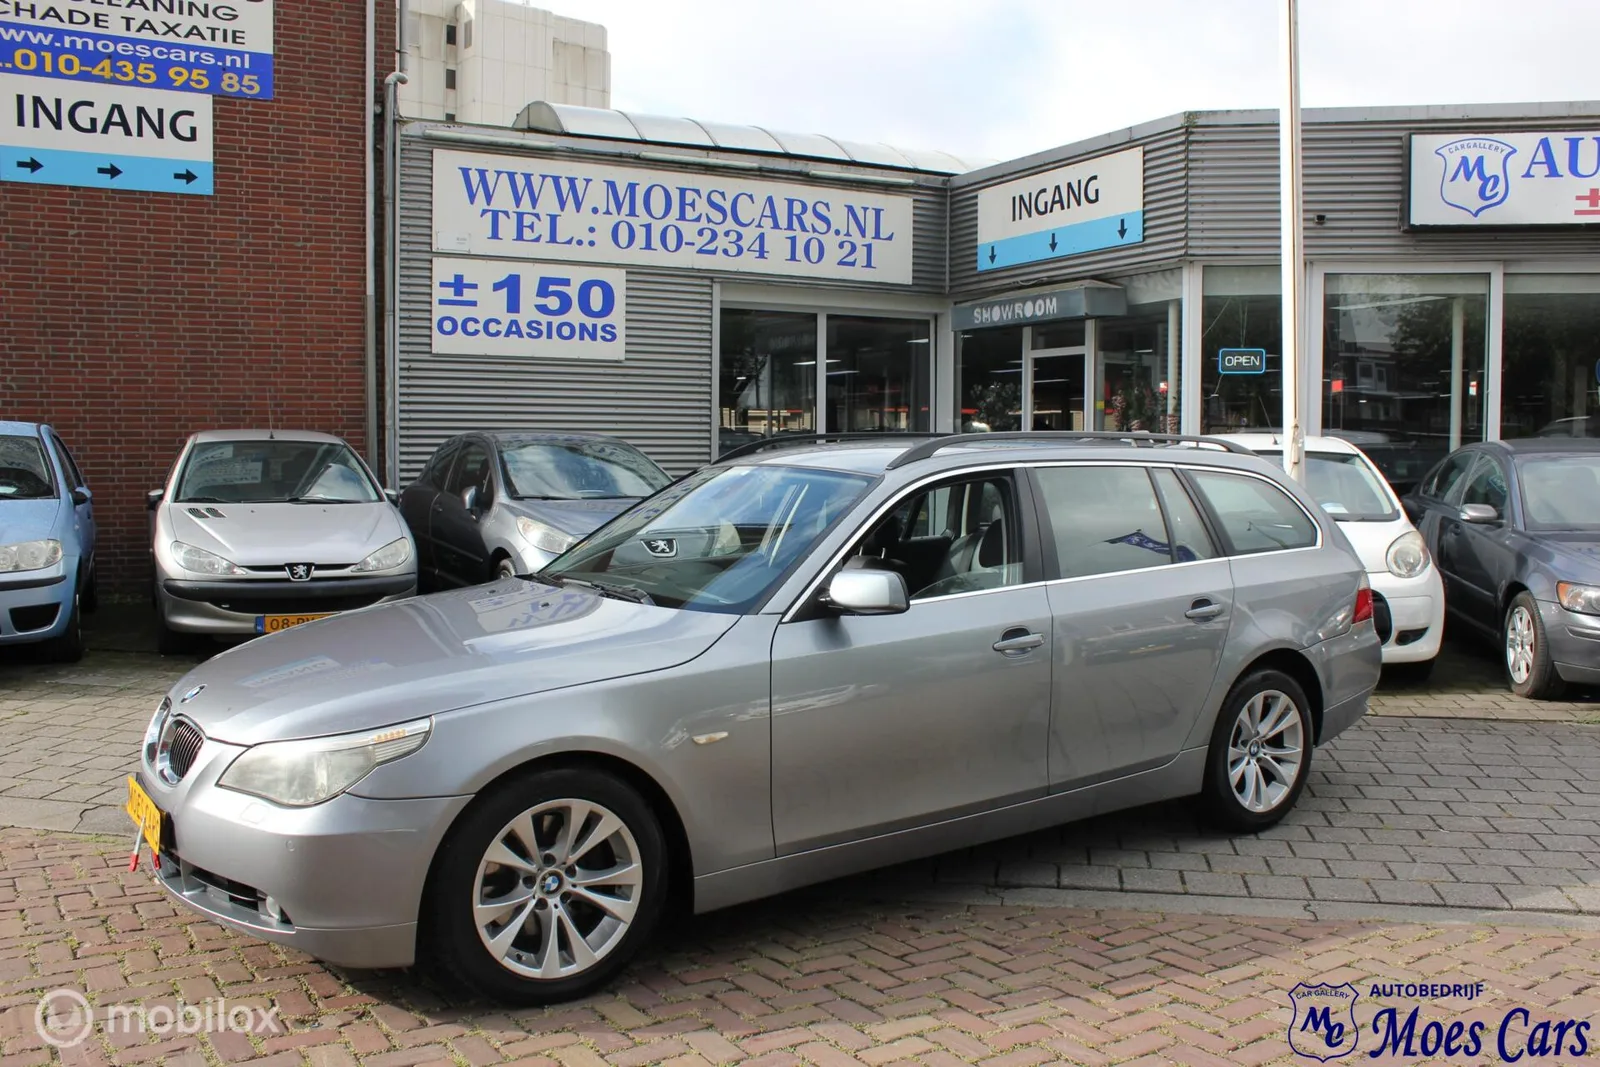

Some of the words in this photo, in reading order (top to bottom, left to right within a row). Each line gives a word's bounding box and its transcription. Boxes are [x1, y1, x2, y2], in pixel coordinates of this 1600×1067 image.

[69, 0, 239, 21] ANING
[121, 16, 246, 45] TAXATIE
[0, 48, 157, 84] .010-435
[168, 66, 210, 90] 95
[221, 72, 260, 95] 85
[16, 94, 198, 142] INGANG
[458, 166, 895, 242] WWW.MOESCARS.NL
[1011, 174, 1100, 222] INGANG
[480, 208, 596, 247] TEL.:
[611, 219, 770, 260] 010-234
[785, 235, 825, 264] 10
[837, 240, 877, 269] 21
[437, 315, 617, 343] OCCASIONS
[973, 297, 1058, 324] SHOWROOM
[1224, 355, 1261, 367] OPEN
